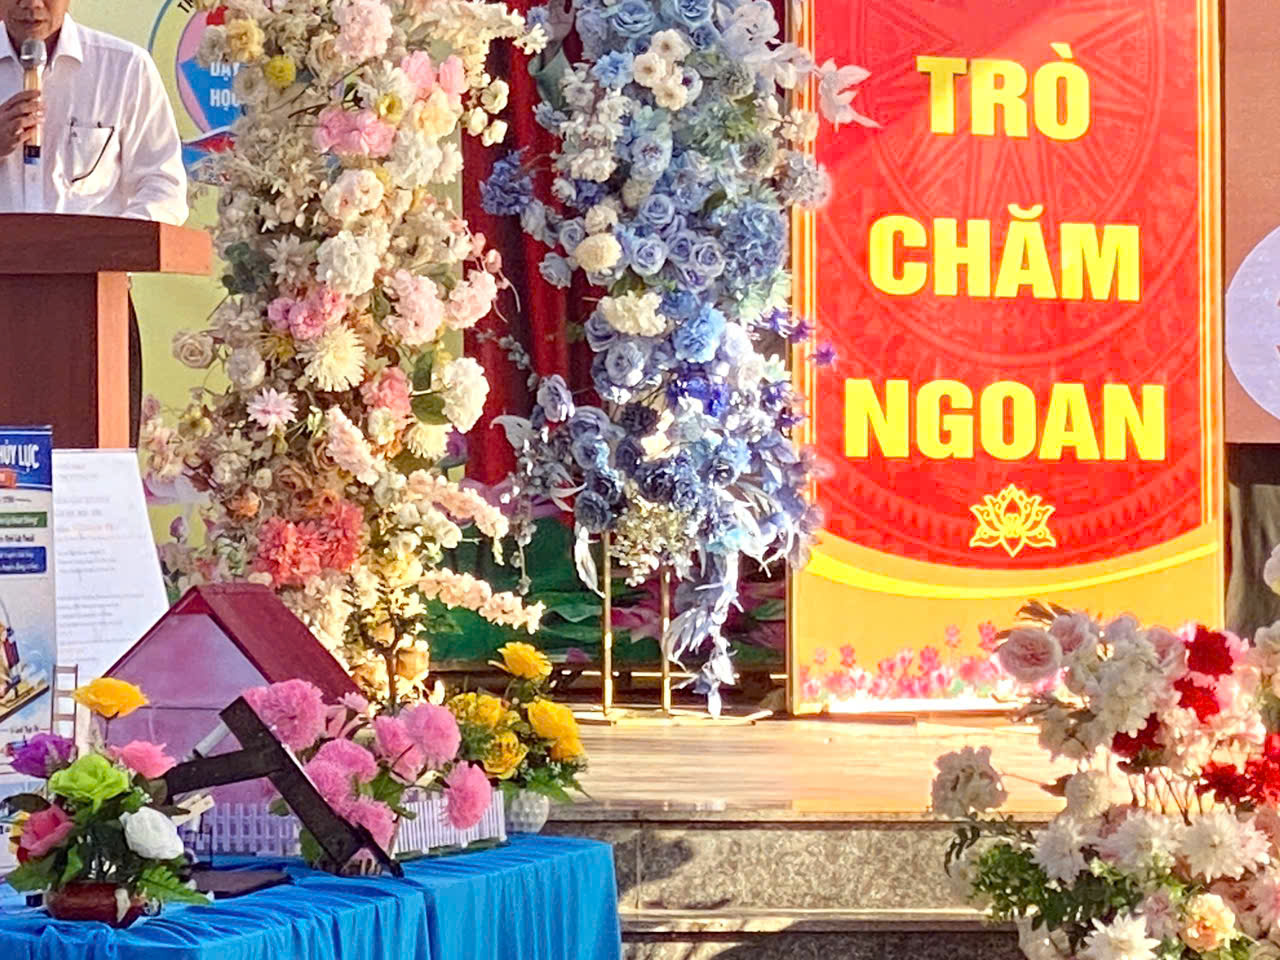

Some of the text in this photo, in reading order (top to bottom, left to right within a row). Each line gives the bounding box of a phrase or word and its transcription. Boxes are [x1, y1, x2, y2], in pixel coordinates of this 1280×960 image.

[915, 41, 1092, 142] TRÒ
[867, 202, 1143, 303] CHĂM
[842, 376, 1167, 462] NGOAN
